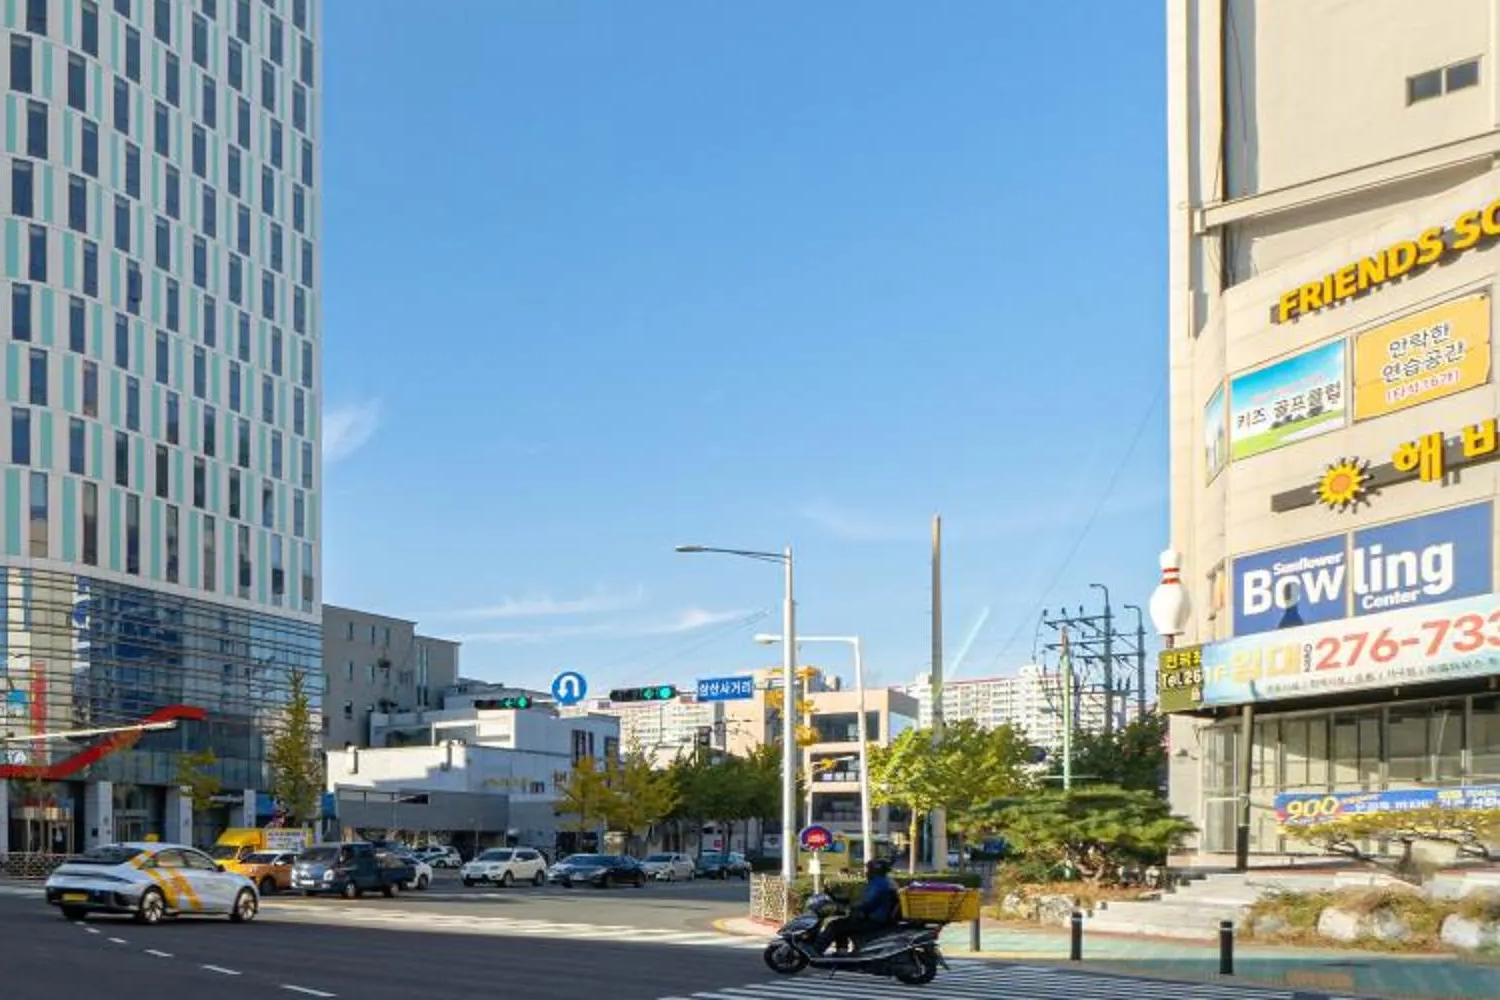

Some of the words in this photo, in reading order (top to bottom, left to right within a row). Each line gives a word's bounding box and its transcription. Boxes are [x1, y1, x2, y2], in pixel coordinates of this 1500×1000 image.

[1278, 226, 1445, 325] FRIENDS
[1382, 341, 1464, 383] 연습공간
[1238, 406, 1268, 430] 키즈
[1243, 541, 1454, 615] Bowling
[1362, 589, 1420, 610] Center
[1286, 796, 1339, 818] 900
